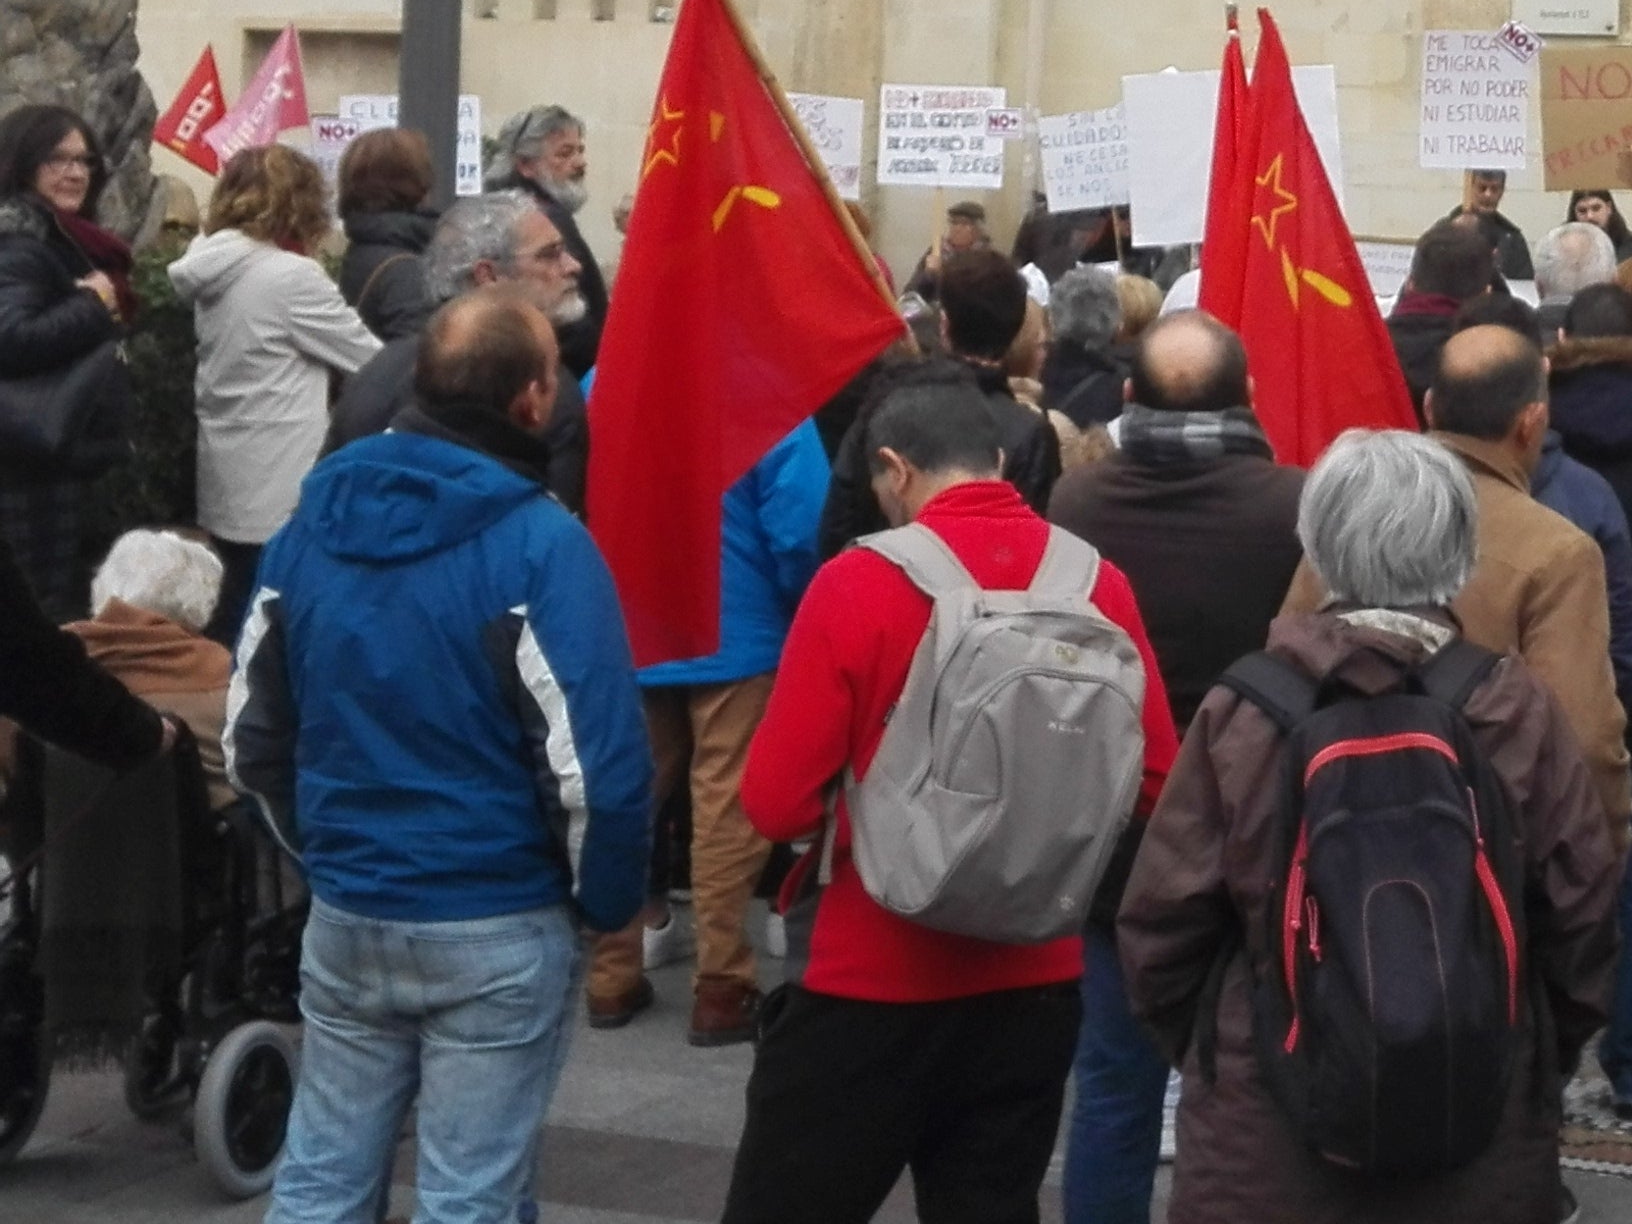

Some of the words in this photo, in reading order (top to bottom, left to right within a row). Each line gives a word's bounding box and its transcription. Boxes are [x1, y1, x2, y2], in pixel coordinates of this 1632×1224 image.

[1427, 35, 1447, 51] ME
[1463, 35, 1500, 51] TOCA
[1504, 24, 1534, 52] NO+
[1426, 55, 1501, 72] EMIGRAR
[1425, 78, 1452, 94] POR
[1460, 79, 1480, 95] NO
[1486, 79, 1528, 97] PODER
[1559, 62, 1632, 101] NO
[988, 114, 1018, 128] NO+
[1423, 105, 1440, 121] NI
[1446, 103, 1520, 122] ESTUDIAR
[319, 126, 355, 139] NO+
[1039, 124, 1127, 149] CUIDADO
[1423, 136, 1440, 154] NI
[1447, 134, 1524, 155] TRABAJAR
